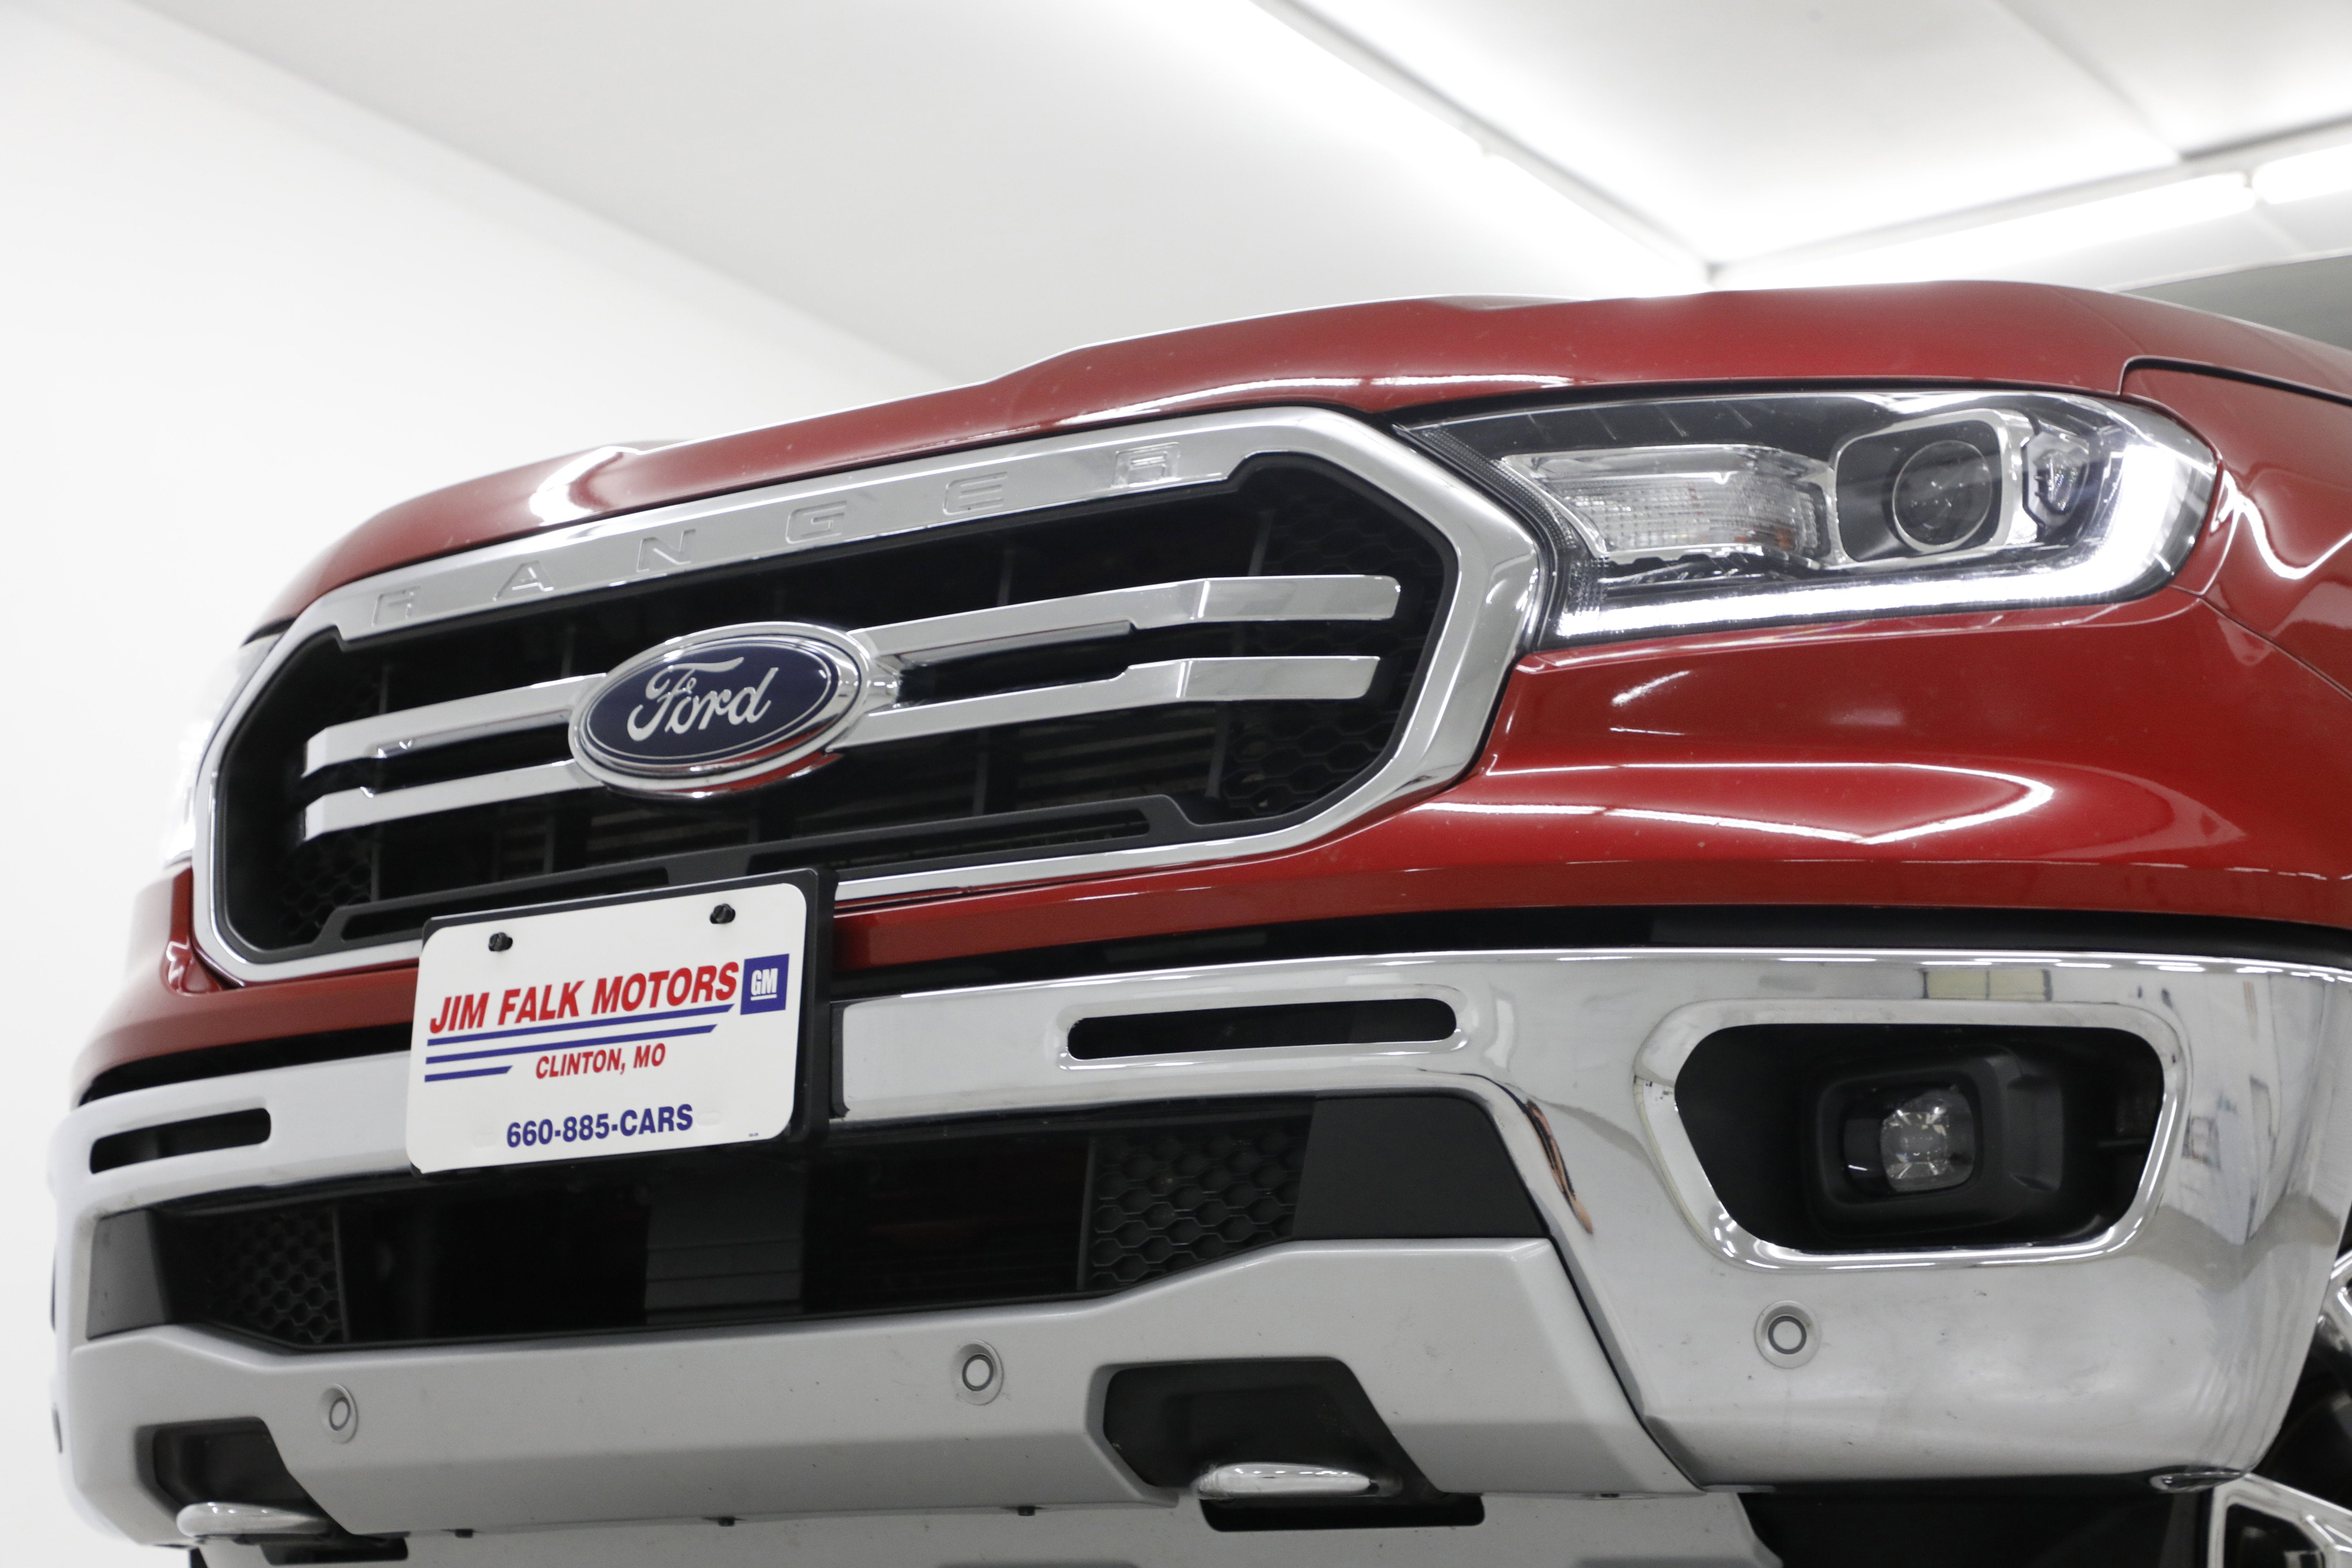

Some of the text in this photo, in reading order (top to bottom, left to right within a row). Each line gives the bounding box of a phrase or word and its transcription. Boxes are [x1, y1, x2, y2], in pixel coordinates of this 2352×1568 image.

[371, 442, 1181, 627] RANGER
[627, 657, 779, 741] Ford
[430, 962, 739, 1033] JIM FALK MOTORS
[751, 968, 778, 996] GM
[536, 1043, 666, 1079] CLINTON, MO
[507, 1103, 693, 1148] 660-885-CARS
